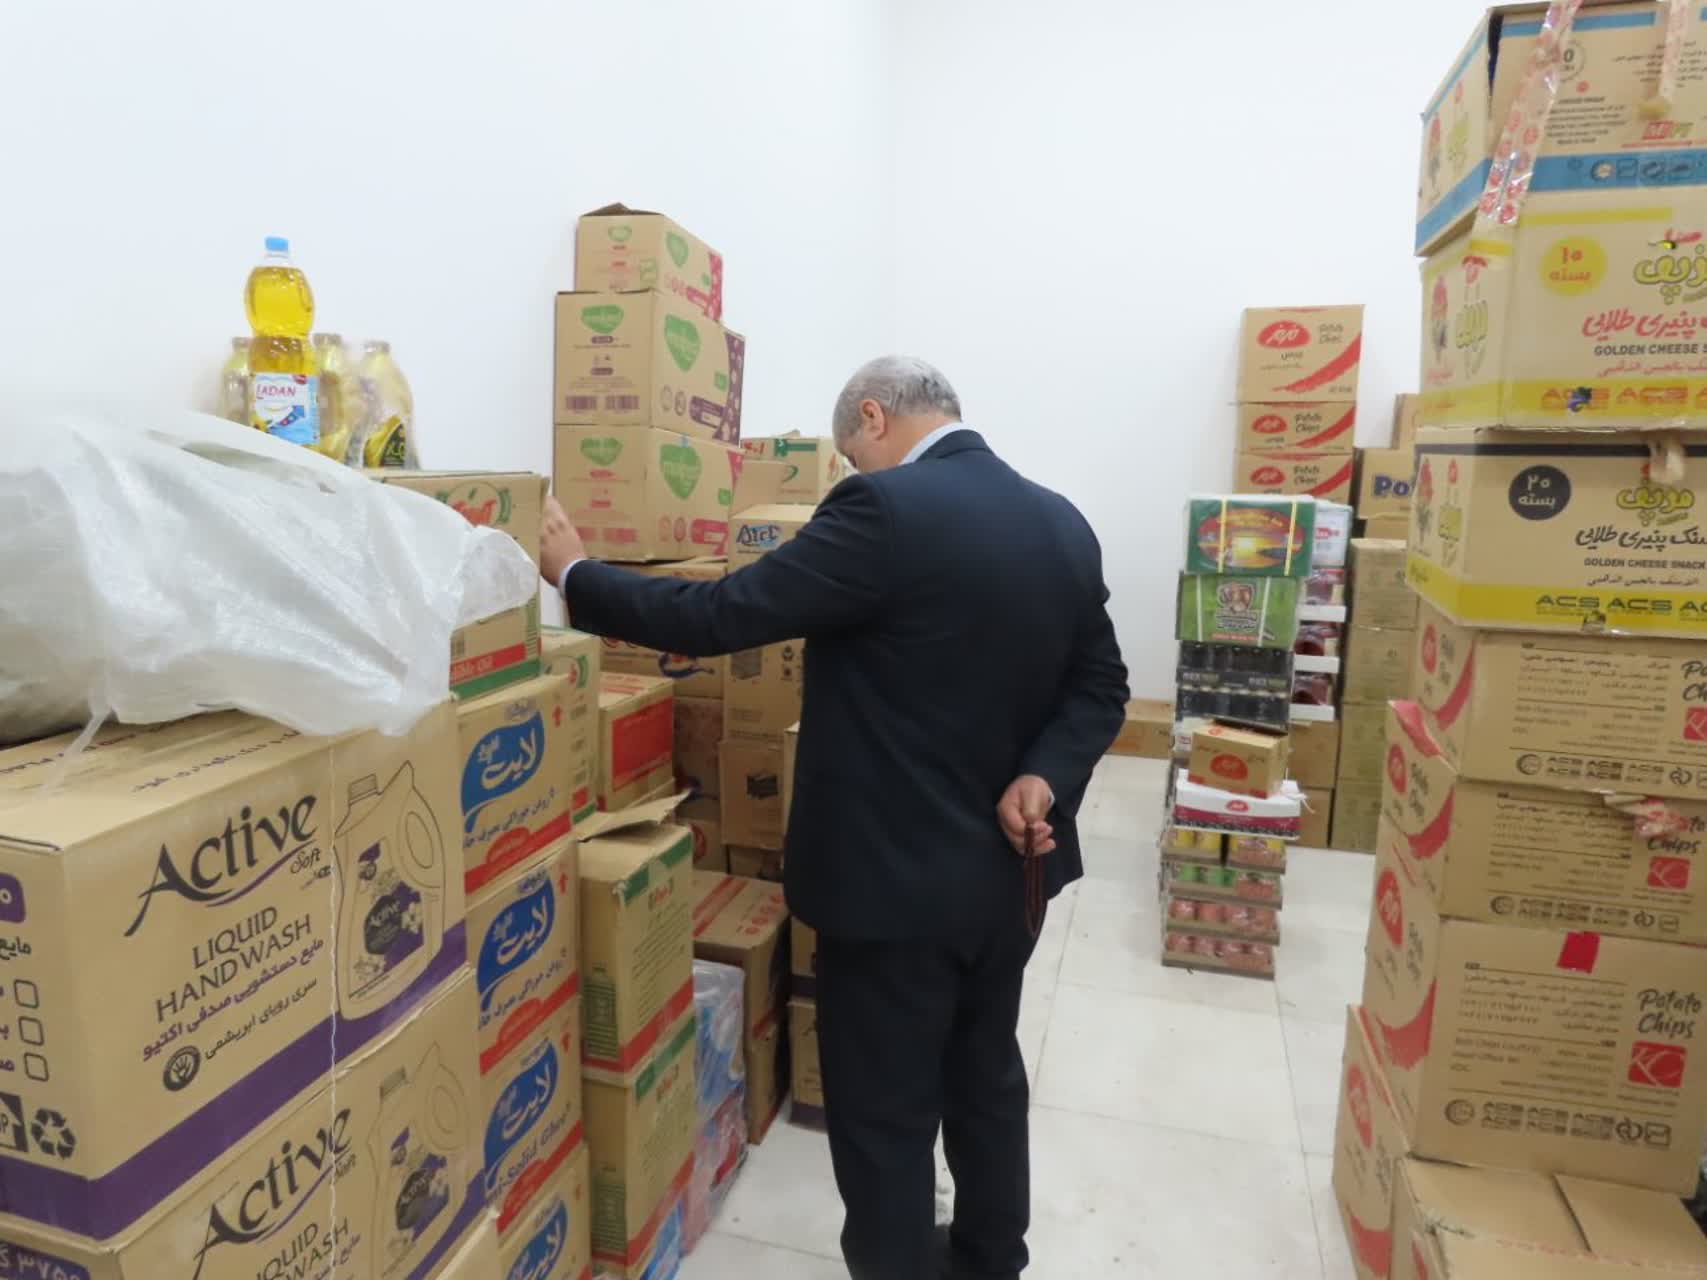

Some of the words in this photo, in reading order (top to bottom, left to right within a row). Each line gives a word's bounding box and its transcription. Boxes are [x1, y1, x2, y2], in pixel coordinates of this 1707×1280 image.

[1594, 344, 1645, 356] GOLDEN
[1648, 343, 1698, 354] CHEESE
[1518, 493, 1556, 509] بسته
[1618, 530, 1666, 552] پنیری
[1584, 558, 1625, 568] GOLDEN
[1628, 559, 1668, 569] CHEESE
[1671, 560, 1705, 570] SNACK
[1536, 594, 1600, 608] ACS
[1607, 598, 1673, 611] ACS
[481, 727, 537, 790] لایت
[123, 795, 318, 936] Active
[192, 906, 278, 970] LIQUID
[497, 896, 548, 966] لایت
[300, 938, 325, 966] مایع
[292, 978, 318, 1004] سری
[1637, 987, 1702, 1015] Potato
[1638, 1012, 1696, 1039] Chips
[143, 1021, 184, 1063] اکتیو
[192, 1108, 352, 1280] Active
